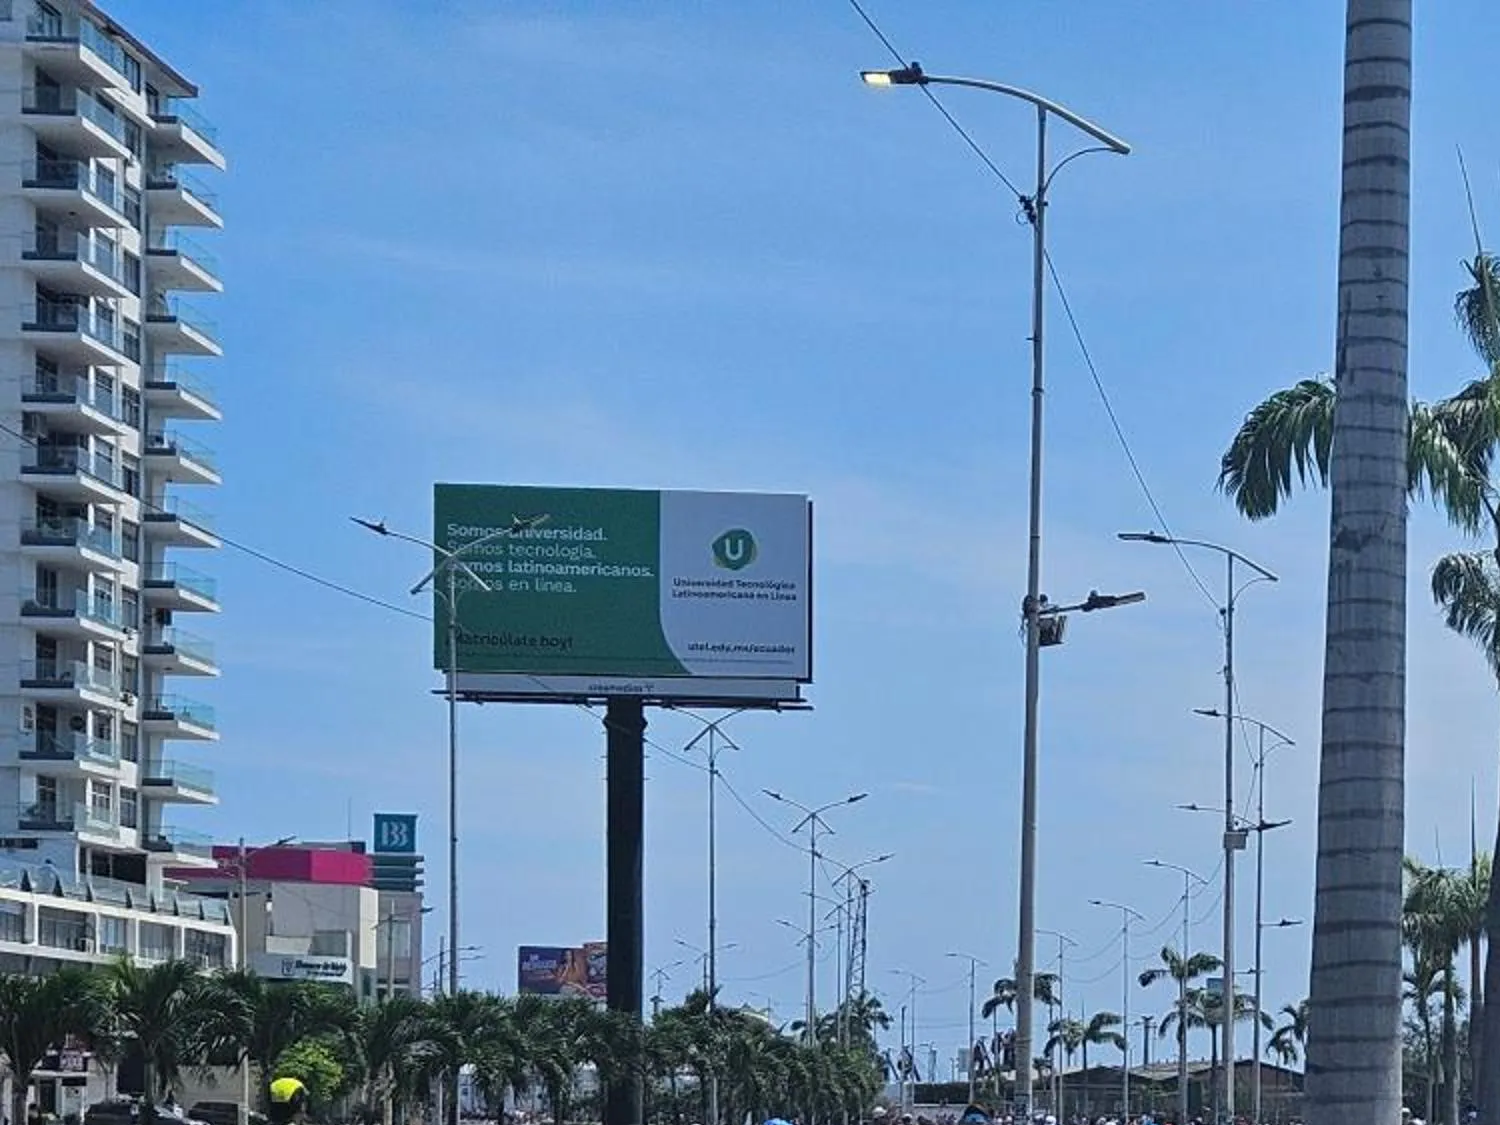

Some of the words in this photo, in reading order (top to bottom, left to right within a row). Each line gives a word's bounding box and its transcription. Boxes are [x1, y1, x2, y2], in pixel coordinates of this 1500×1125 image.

[725, 537, 744, 560] U
[508, 559, 655, 577] latinoamericanos.
[508, 579, 529, 591] en
